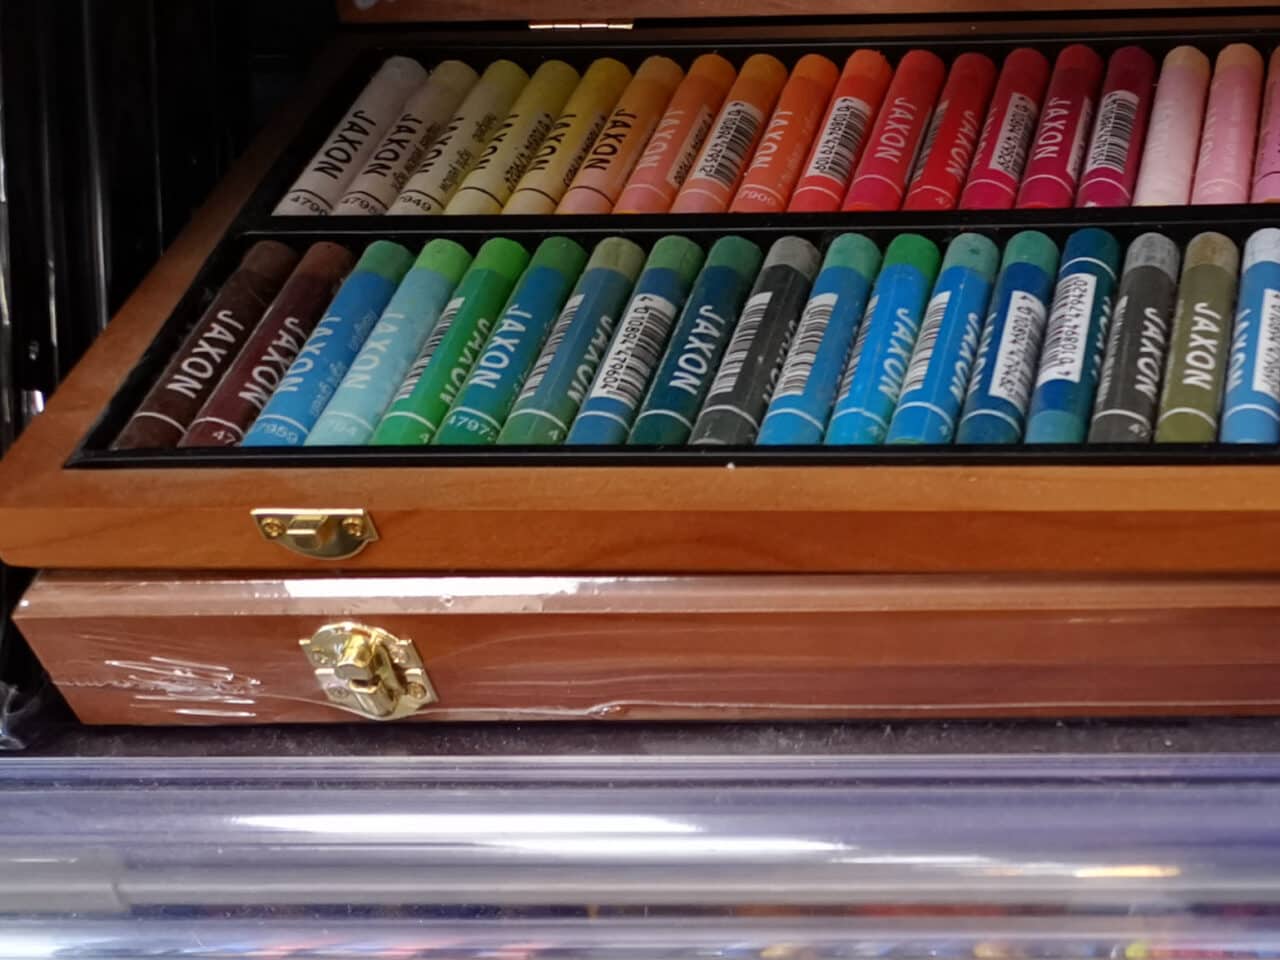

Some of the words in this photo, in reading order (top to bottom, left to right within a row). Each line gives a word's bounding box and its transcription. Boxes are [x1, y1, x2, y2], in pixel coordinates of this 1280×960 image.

[314, 110, 376, 180] JAXON
[362, 112, 424, 178] JAXON
[583, 108, 637, 172] JAXON
[640, 106, 682, 169] JAXON
[751, 110, 794, 169] JAXON
[873, 96, 918, 165] JAXON
[1033, 96, 1071, 161] JAXON
[167, 309, 245, 399] JAXON
[240, 316, 306, 409] JAXON
[276, 314, 342, 397] JAXON
[350, 312, 406, 389] JAXON
[468, 303, 533, 389] JAXON
[668, 305, 726, 396] JAXON
[1135, 307, 1165, 400] JAXON
[1182, 302, 1222, 390] JAXON
